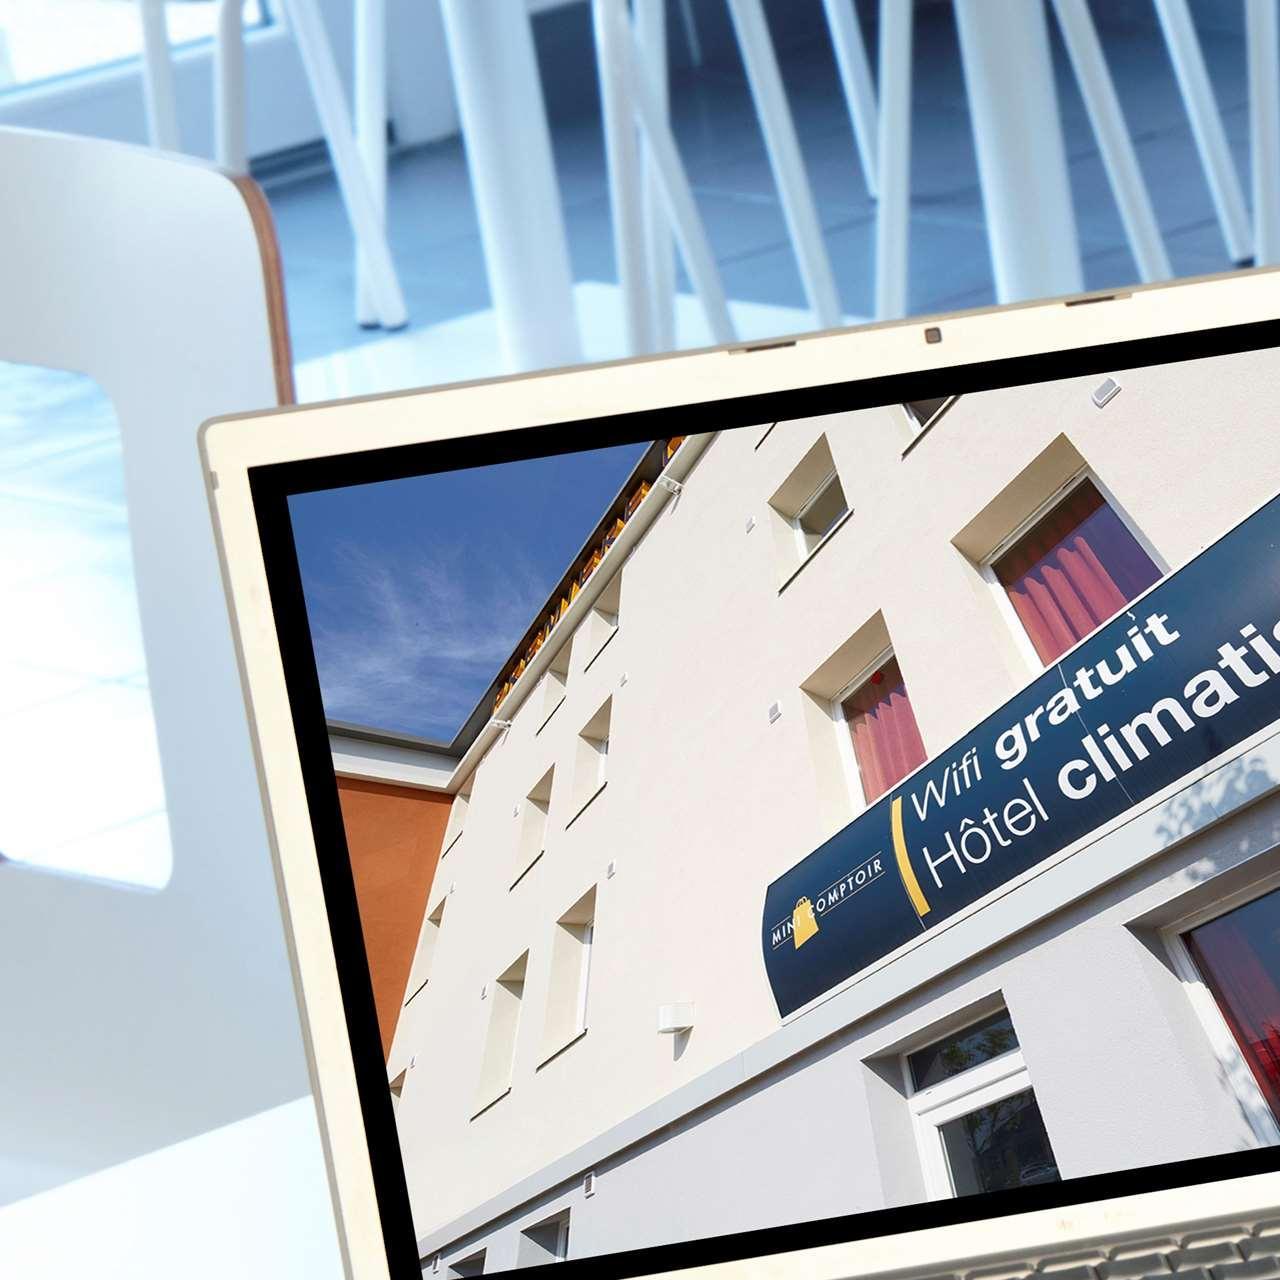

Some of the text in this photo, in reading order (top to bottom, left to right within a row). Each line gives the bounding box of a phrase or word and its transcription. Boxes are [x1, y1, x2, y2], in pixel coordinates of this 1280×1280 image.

[911, 613, 1180, 821] Wifi gratuit
[922, 778, 1049, 888] Hôtel
[808, 859, 882, 918] COMPTOIR
